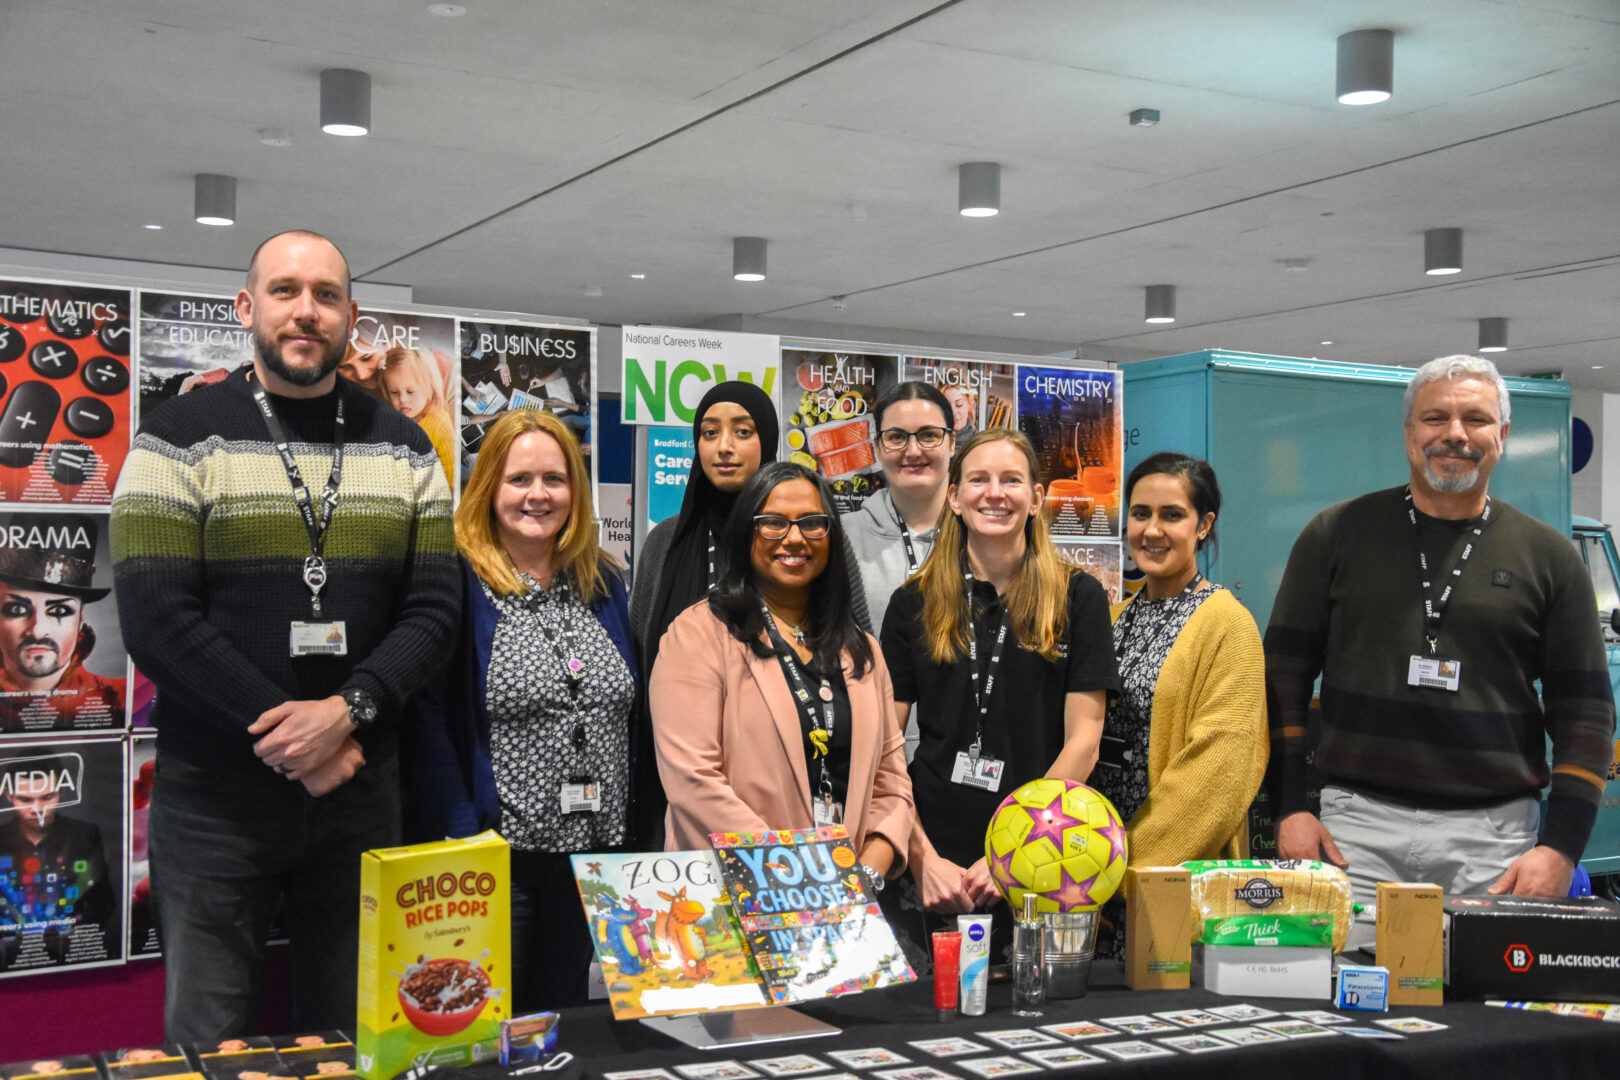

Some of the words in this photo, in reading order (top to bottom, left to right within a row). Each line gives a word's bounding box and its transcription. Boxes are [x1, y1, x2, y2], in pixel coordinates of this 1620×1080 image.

[0, 294, 118, 322] THEMATICS
[625, 333, 661, 346] National
[663, 335, 697, 349] Careers
[699, 337, 722, 350] Week
[810, 362, 875, 386] HEALTH
[924, 366, 993, 388] ENGLISH
[834, 385, 850, 394] AND
[1025, 375, 1112, 399] CHEMISTRY
[259, 399, 273, 418] STAFF
[817, 395, 868, 417] FOOD
[21, 441, 42, 451] using
[43, 443, 94, 451] mathematics
[654, 438, 687, 449] Bradford
[302, 505, 314, 526] STAFF
[1408, 509, 1417, 524] STAFF
[1482, 506, 1491, 520] STAFF
[1420, 552, 1428, 570] STAFF
[1462, 543, 1473, 560] STAFF
[1440, 585, 1452, 601] STAFF
[764, 612, 776, 630] STAFF
[997, 624, 1007, 644] STAFF
[788, 662, 801, 682] STAFF
[53, 688, 78, 696] drama
[986, 674, 995, 695] STAFF
[621, 857, 718, 891] ZOG
[735, 842, 838, 889] YOU
[396, 870, 497, 909] CHOCO
[757, 882, 848, 914] CHOOSE
[1238, 888, 1282, 899] MORRIS
[24, 920, 48, 929] using
[49, 916, 77, 926] media
[405, 902, 443, 928] RICE
[447, 900, 489, 919] POPS
[433, 924, 471, 938] Sainsbury's
[1244, 919, 1283, 940] Thick
[770, 929, 796, 952] IN
[966, 941, 986, 953] soft
[1539, 953, 1620, 969] BLACKROCK
